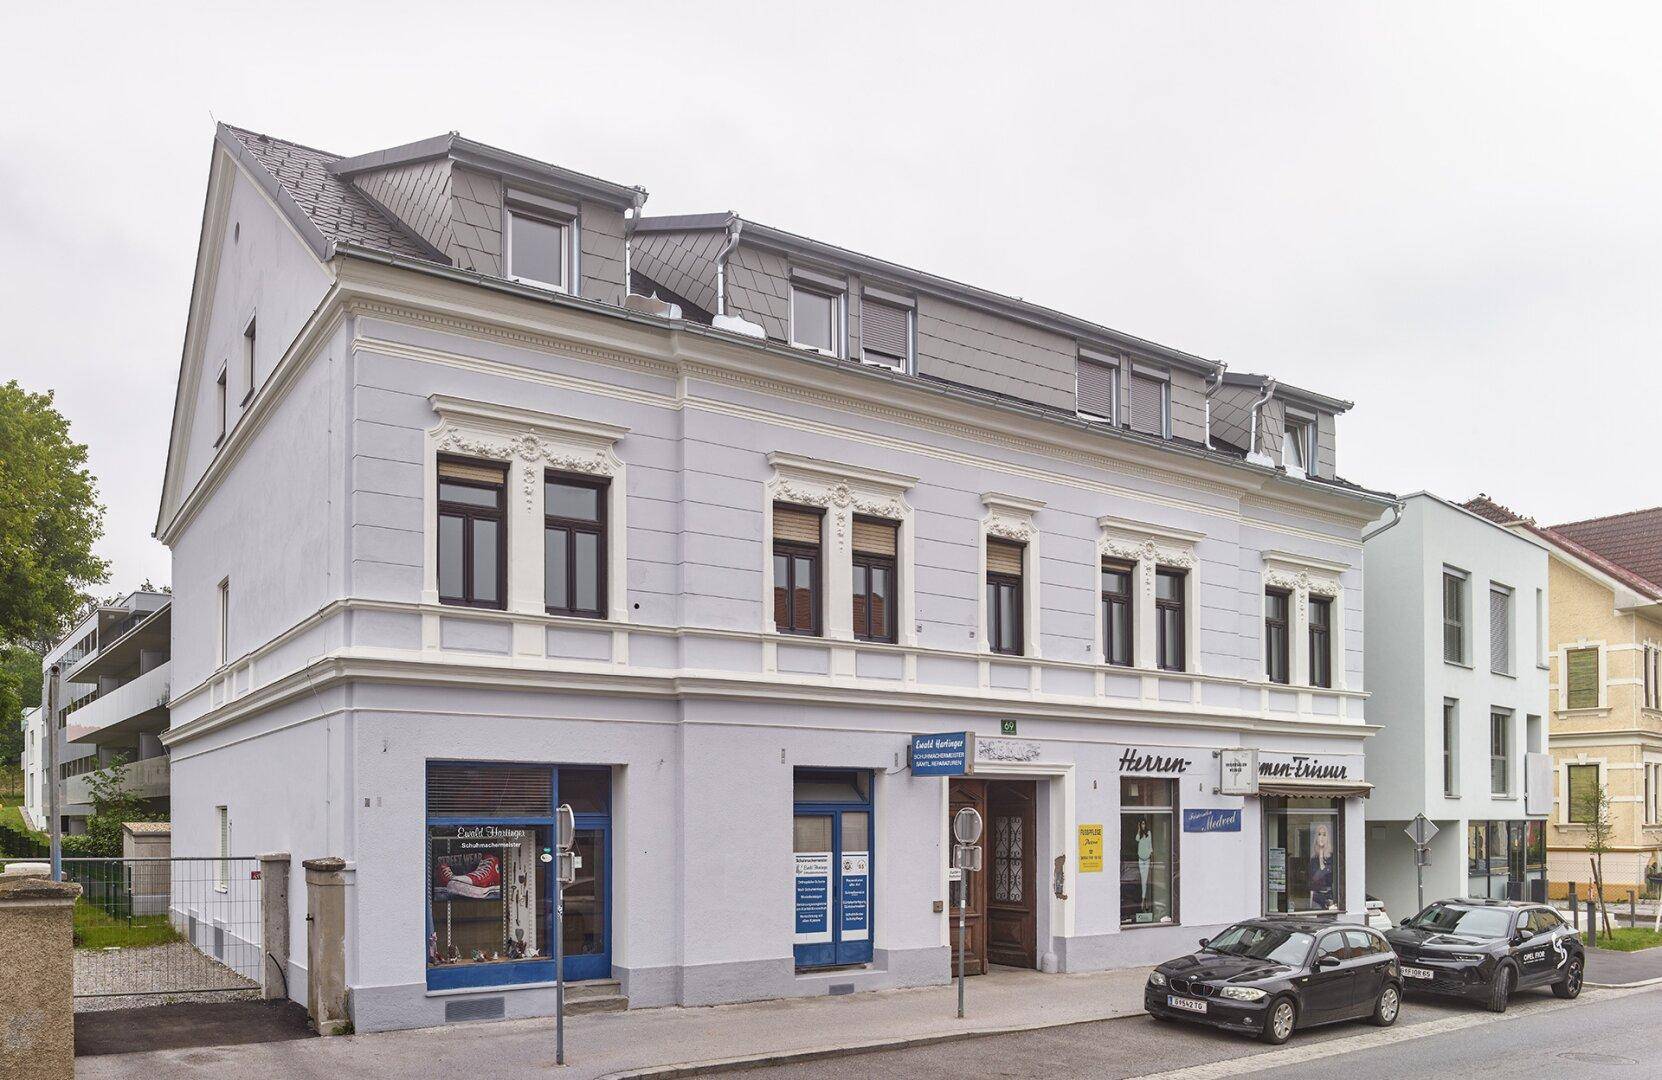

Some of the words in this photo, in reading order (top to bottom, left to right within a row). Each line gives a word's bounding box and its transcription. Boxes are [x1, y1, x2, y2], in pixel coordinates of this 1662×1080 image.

[1004, 721, 1014, 731] 69
[915, 739, 934, 749] Ewald
[1118, 748, 1192, 773] Herren-
[1259, 756, 1347, 779] men-Friseur
[457, 826, 484, 839] Ewald
[1523, 953, 1535, 961] OPEL
